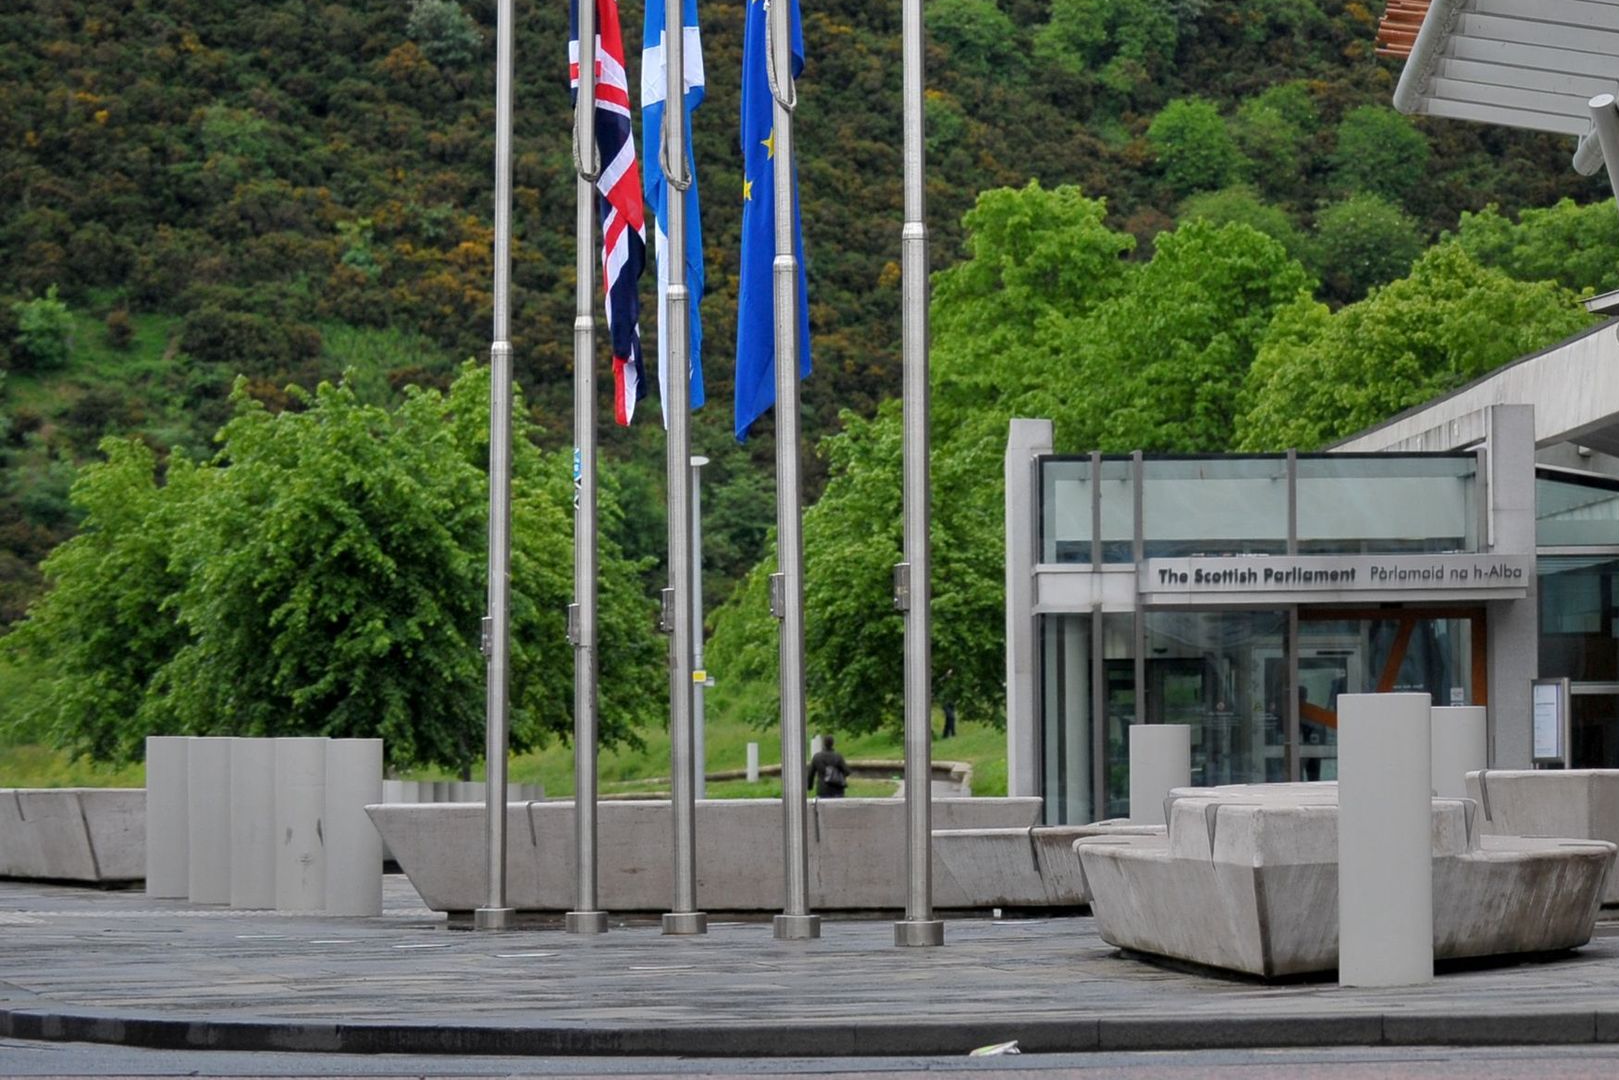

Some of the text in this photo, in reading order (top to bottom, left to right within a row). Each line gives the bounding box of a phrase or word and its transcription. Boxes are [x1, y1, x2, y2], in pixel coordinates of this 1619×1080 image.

[1158, 565, 1356, 585] The Scottish Parliament
[1370, 563, 1523, 581] Pàrlamaid na h-Alba
